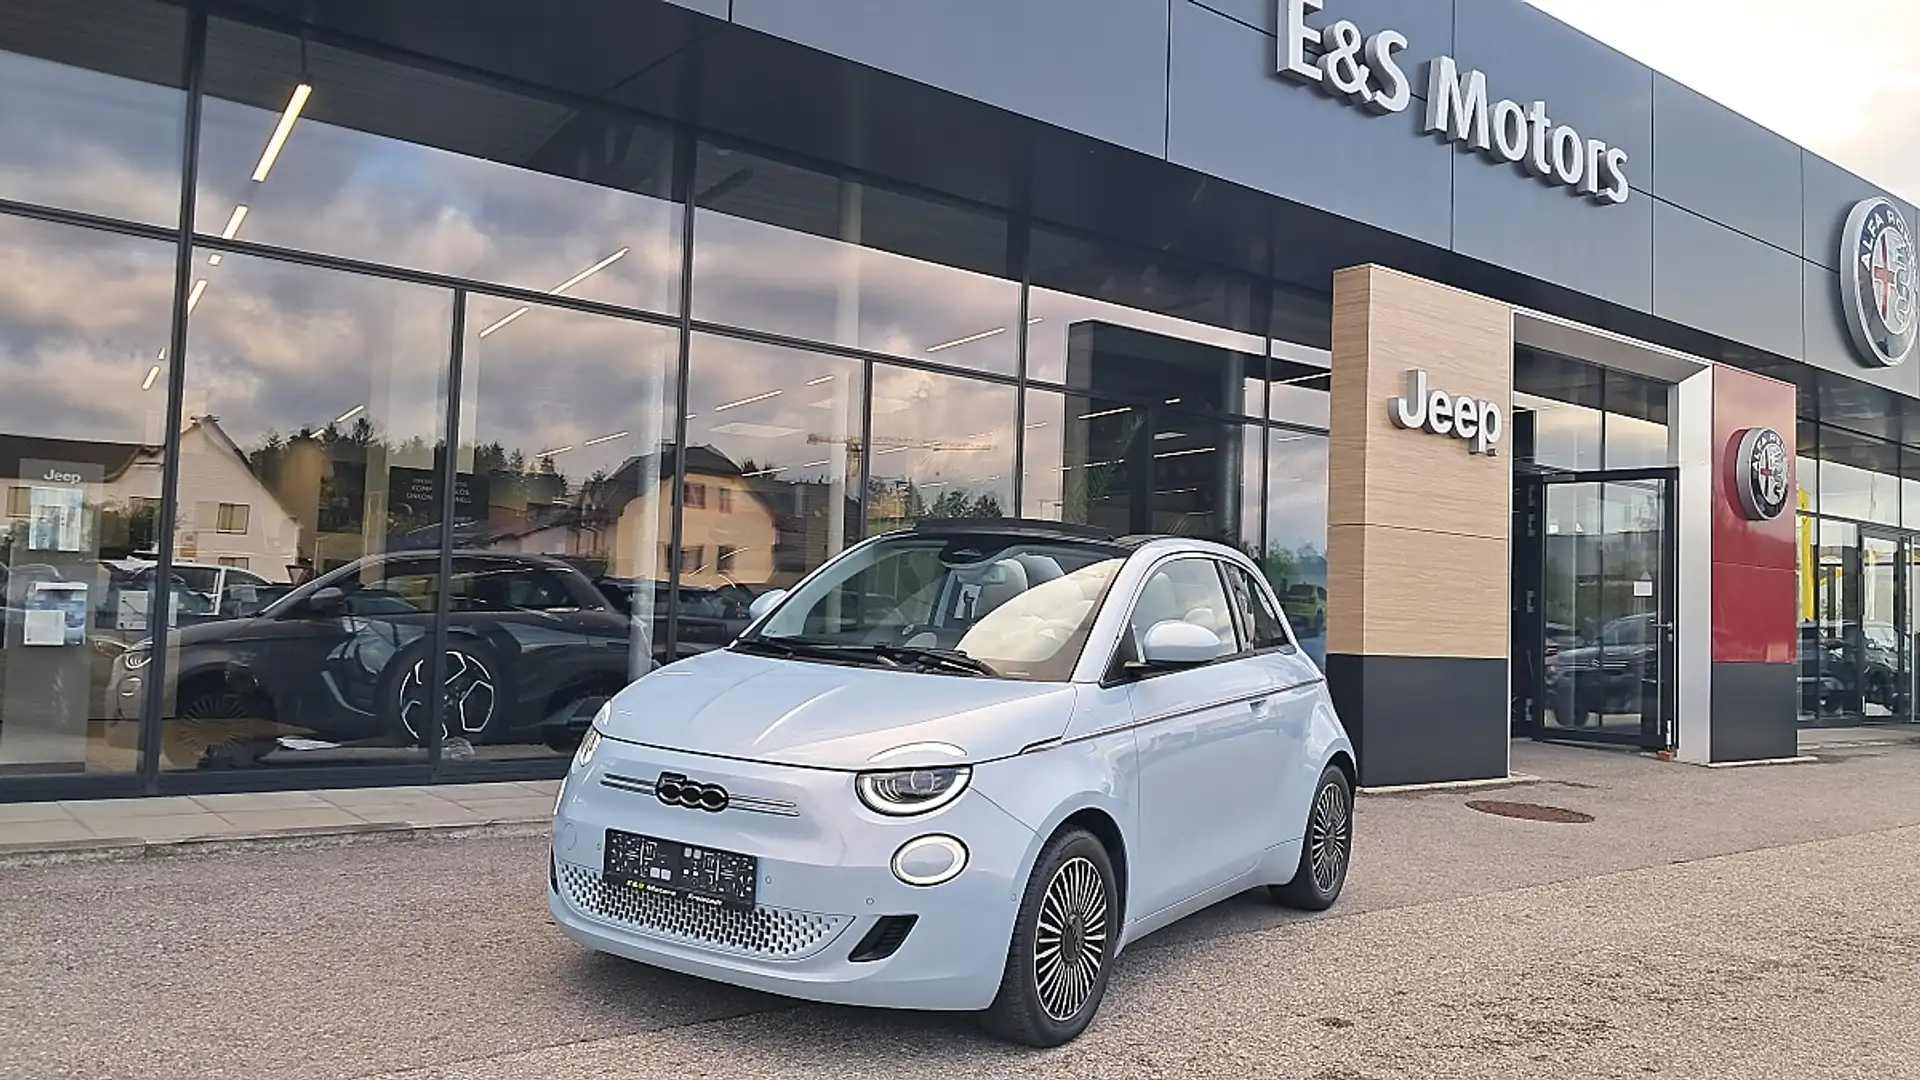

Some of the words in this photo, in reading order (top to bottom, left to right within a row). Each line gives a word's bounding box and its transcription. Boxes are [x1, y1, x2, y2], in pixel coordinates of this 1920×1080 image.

[1277, 0, 1411, 114] E&S
[1424, 56, 1629, 204] Motors
[1861, 212, 1885, 271] ALFA
[1389, 369, 1502, 454] Jeep
[44, 469, 81, 484] Jeep
[656, 771, 729, 813] 500
